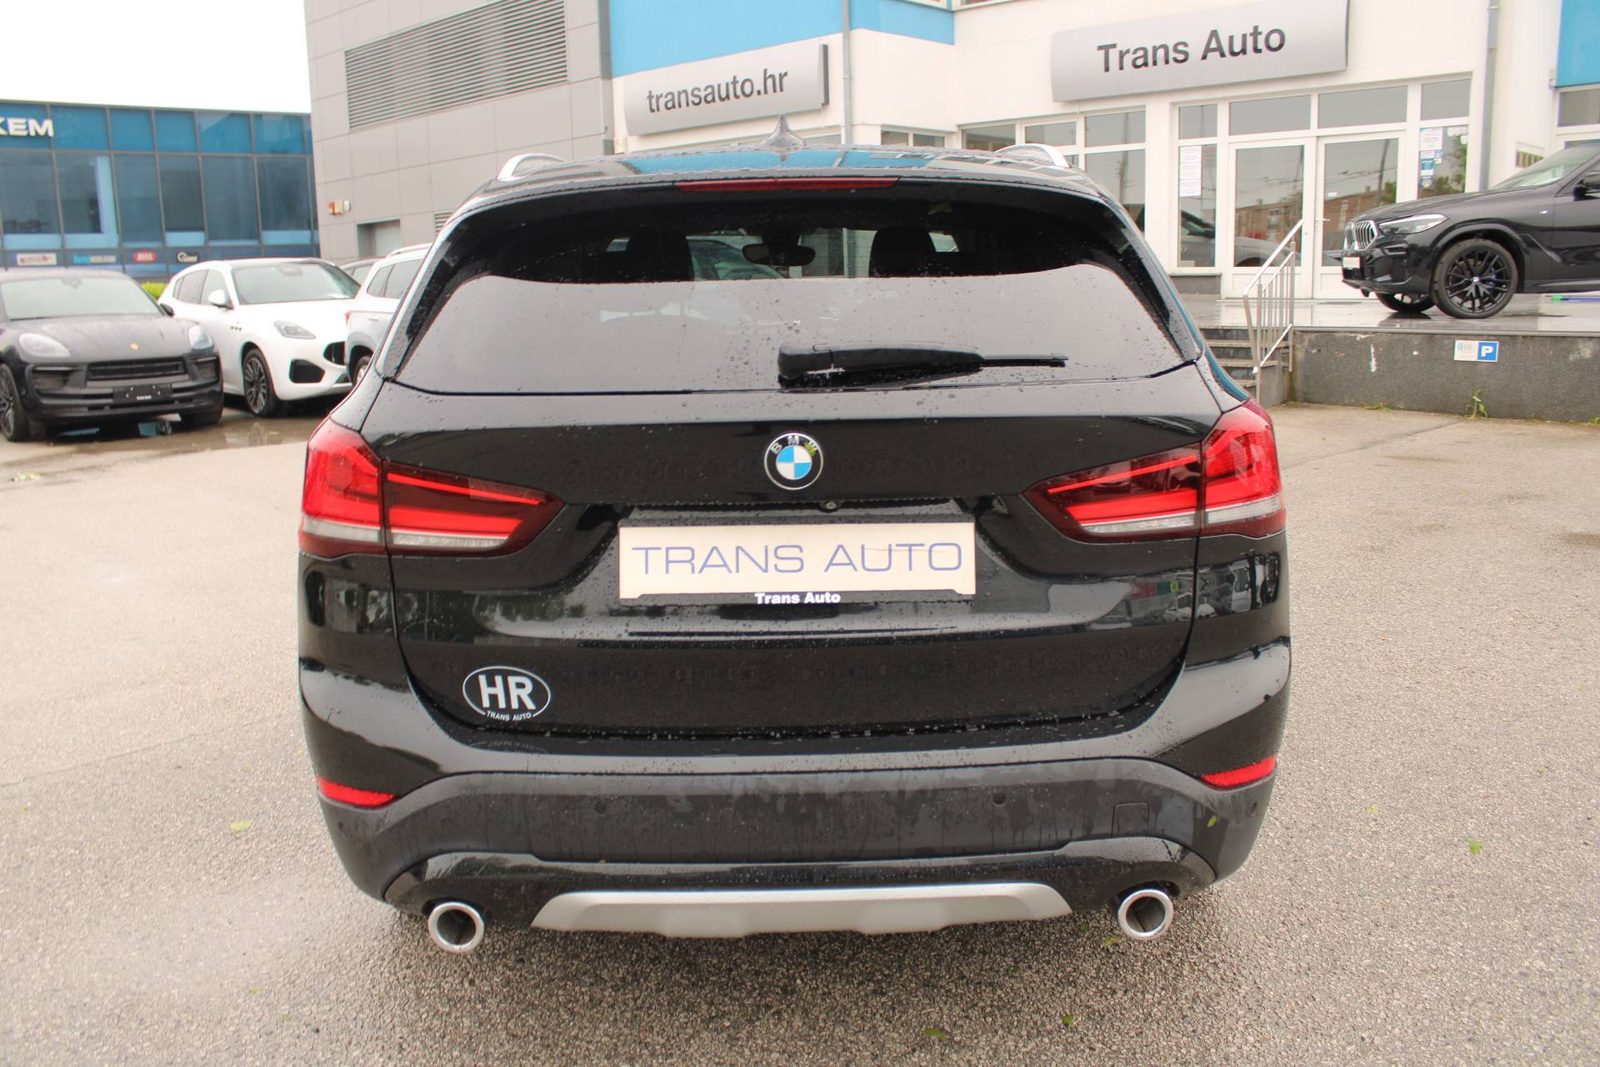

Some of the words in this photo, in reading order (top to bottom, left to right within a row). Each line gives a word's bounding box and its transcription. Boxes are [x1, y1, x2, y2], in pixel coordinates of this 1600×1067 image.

[1097, 40, 1190, 73] Trans
[1201, 25, 1286, 61] Auto
[647, 68, 788, 113] transauto.hr
[1481, 345, 1494, 358] P
[632, 544, 804, 575] TRANS
[824, 542, 962, 573] AUTO
[754, 592, 800, 605] Trans
[804, 591, 841, 604] Auto
[478, 674, 536, 710] HR
[486, 710, 510, 722] TRANS
[512, 712, 532, 721] AUTO
